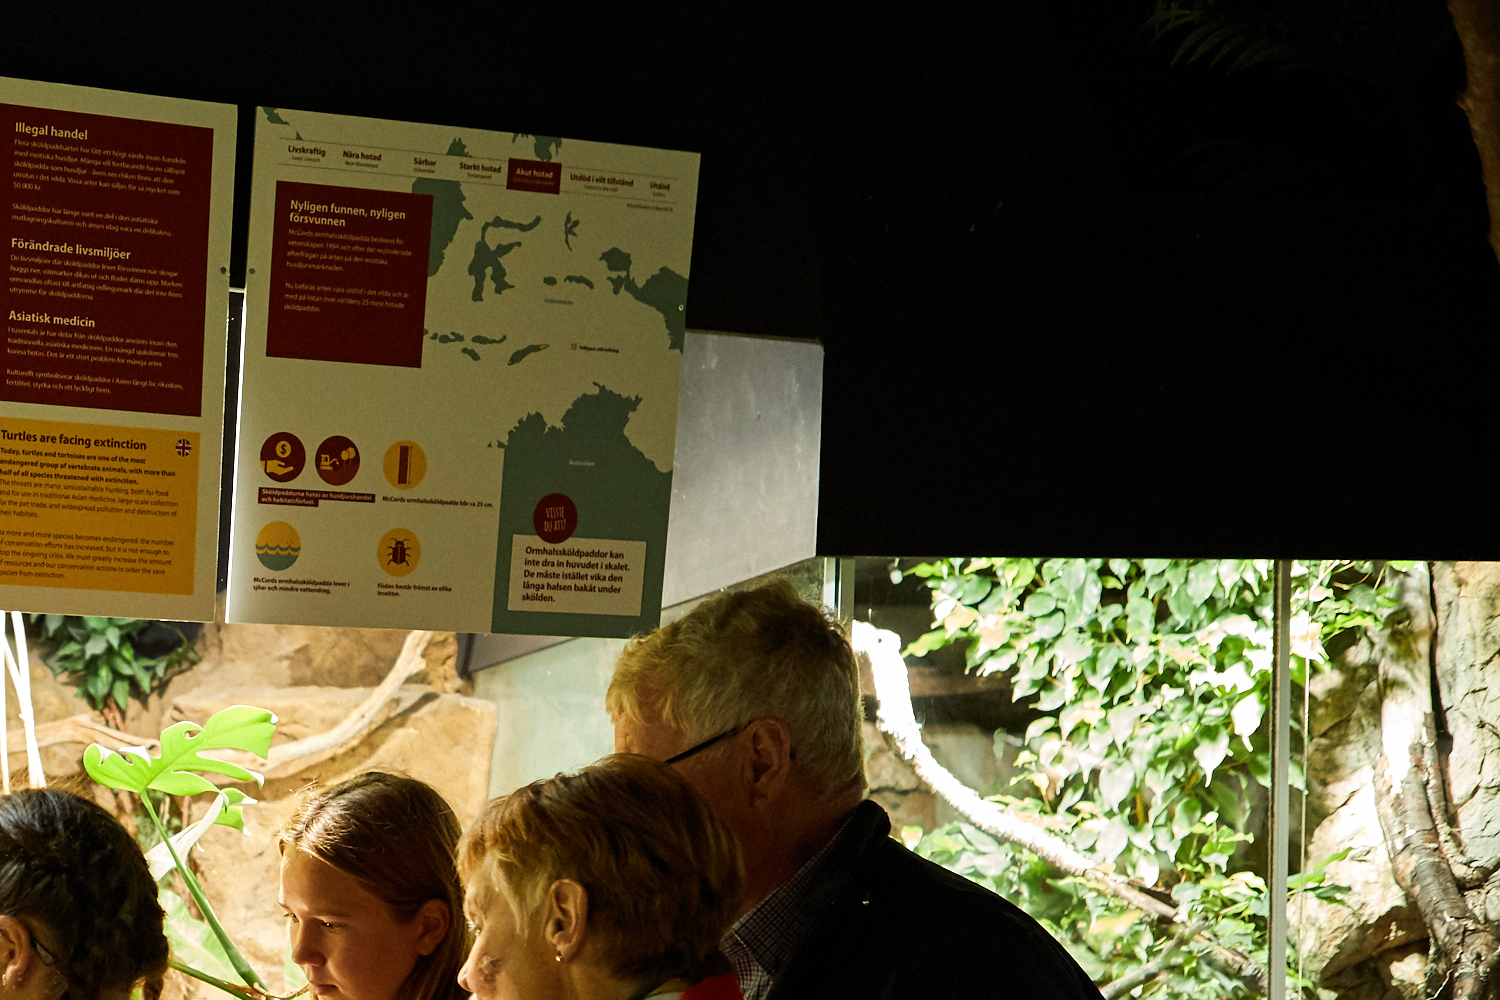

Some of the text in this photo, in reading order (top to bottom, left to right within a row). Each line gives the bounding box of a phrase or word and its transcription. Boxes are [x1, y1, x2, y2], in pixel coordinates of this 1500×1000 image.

[15, 121, 88, 141] Illegal handel
[287, 144, 326, 158] Livskraftig
[342, 150, 382, 162] Nära hotad
[413, 157, 437, 167] Sårbar
[459, 161, 502, 174] Starkt hotad
[515, 167, 554, 179] Akut hotad
[570, 173, 592, 183] Utdöd
[595, 176, 606, 184] vilt
[606, 177, 634, 187] tillstånd
[290, 199, 406, 221] Nyligen funnen, nyligen
[289, 211, 346, 227] försvunnen
[11, 237, 131, 261] Förändrade livsmiljöer
[8, 309, 95, 328] Asiatisk medicin
[0, 429, 147, 451] Turtles are facing extinction
[0, 446, 21, 456] Today,
[21, 449, 43, 457] turtles
[57, 452, 86, 460] tortoises
[110, 454, 118, 462] of
[118, 455, 129, 463] the
[545, 506, 565, 519] VISSTE
[543, 518, 567, 533] DU ATT?
[525, 545, 625, 560] Ormhalssköldpaddor kan
[524, 557, 541, 567] inte
[541, 558, 556, 568] dra
[556, 559, 565, 568] in
[565, 559, 600, 570] huvudet
[604, 561, 631, 571] skalet.
[523, 569, 623, 583] De måste istället vika den
[522, 580, 622, 594] långa halsen bakåt under
[521, 592, 556, 602] skölden.
